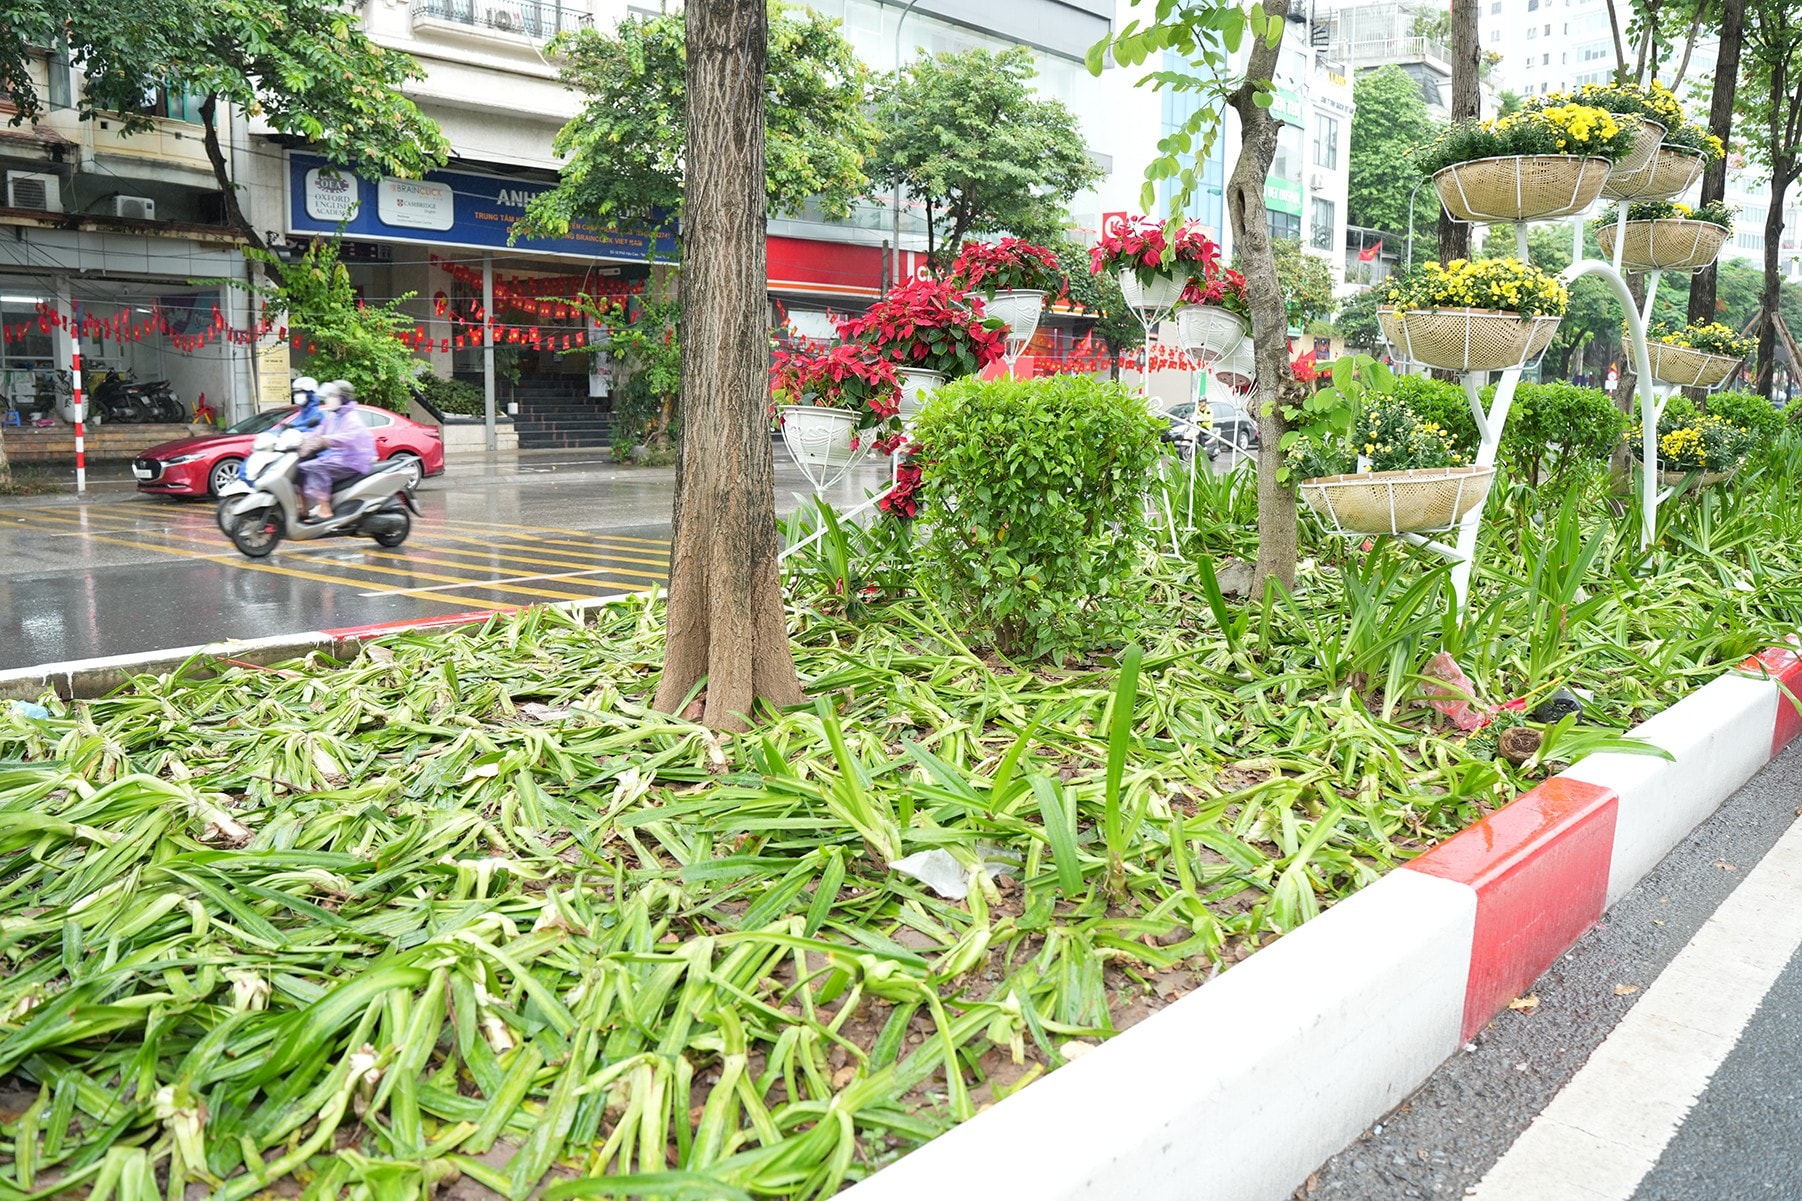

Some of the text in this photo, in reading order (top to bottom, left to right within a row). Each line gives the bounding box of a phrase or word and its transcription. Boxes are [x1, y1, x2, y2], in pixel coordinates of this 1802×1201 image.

[315, 193, 350, 202] OXFORD
[497, 188, 536, 207] ANH
[315, 201, 351, 210] ENGLISH
[404, 201, 436, 209] CAMBRIDGE
[475, 211, 499, 221] TRUNG
